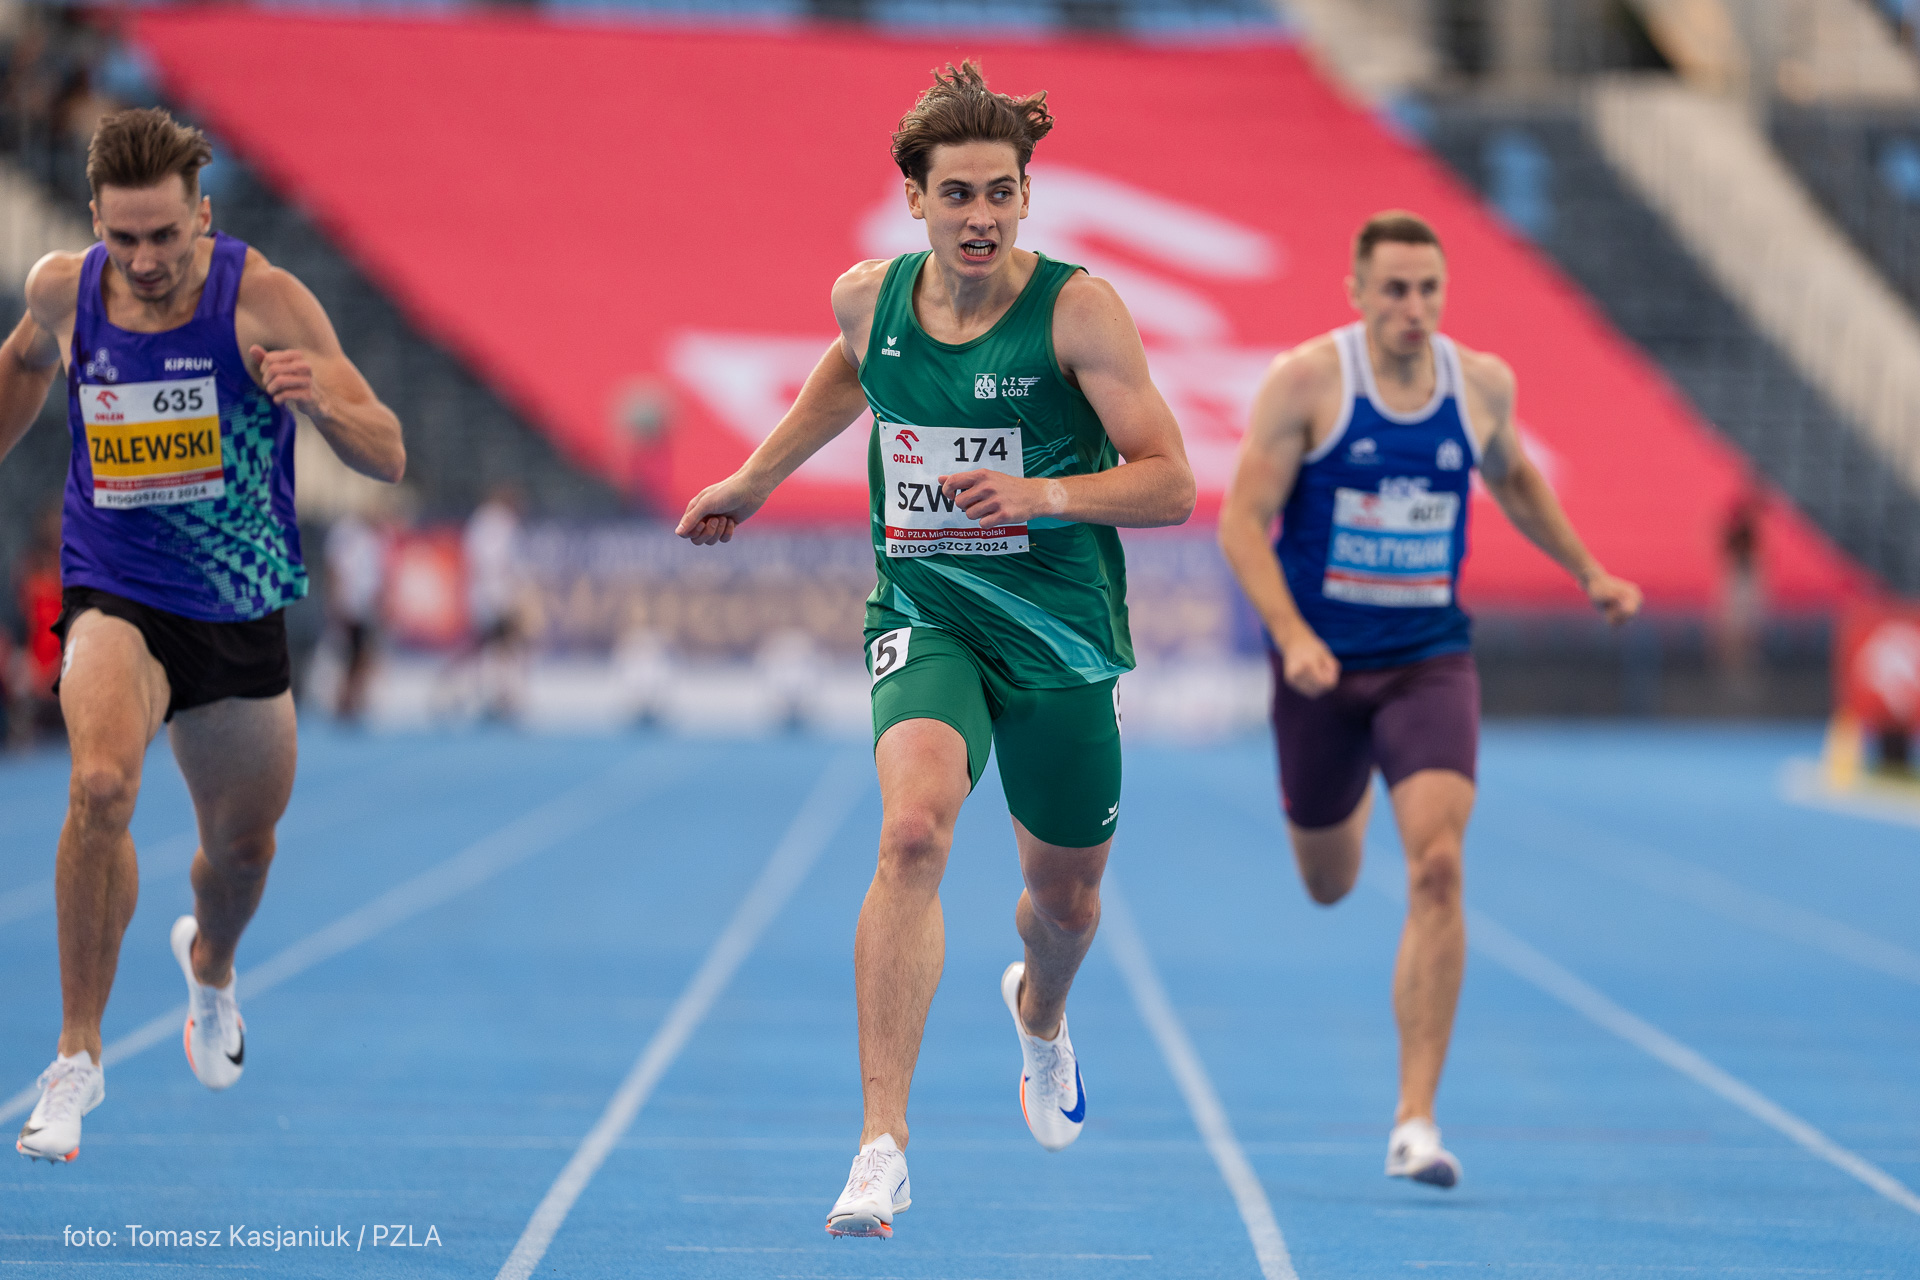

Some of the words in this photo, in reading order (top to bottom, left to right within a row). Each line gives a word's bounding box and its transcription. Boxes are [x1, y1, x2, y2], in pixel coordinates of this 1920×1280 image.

[881, 347, 901, 357] erima
[164, 357, 213, 371] KIPRUN
[153, 387, 203, 413] 635
[91, 430, 214, 464] ZALEWSKI
[953, 436, 1009, 462] 174
[893, 453, 924, 465] ORLEN
[893, 529, 907, 538] 100.
[929, 529, 980, 538] Mistrzostwa
[981, 527, 1006, 537] Polski
[890, 541, 973, 554] BYDGOSZCZ
[976, 541, 1009, 552] 2024
[875, 632, 898, 676] 5
